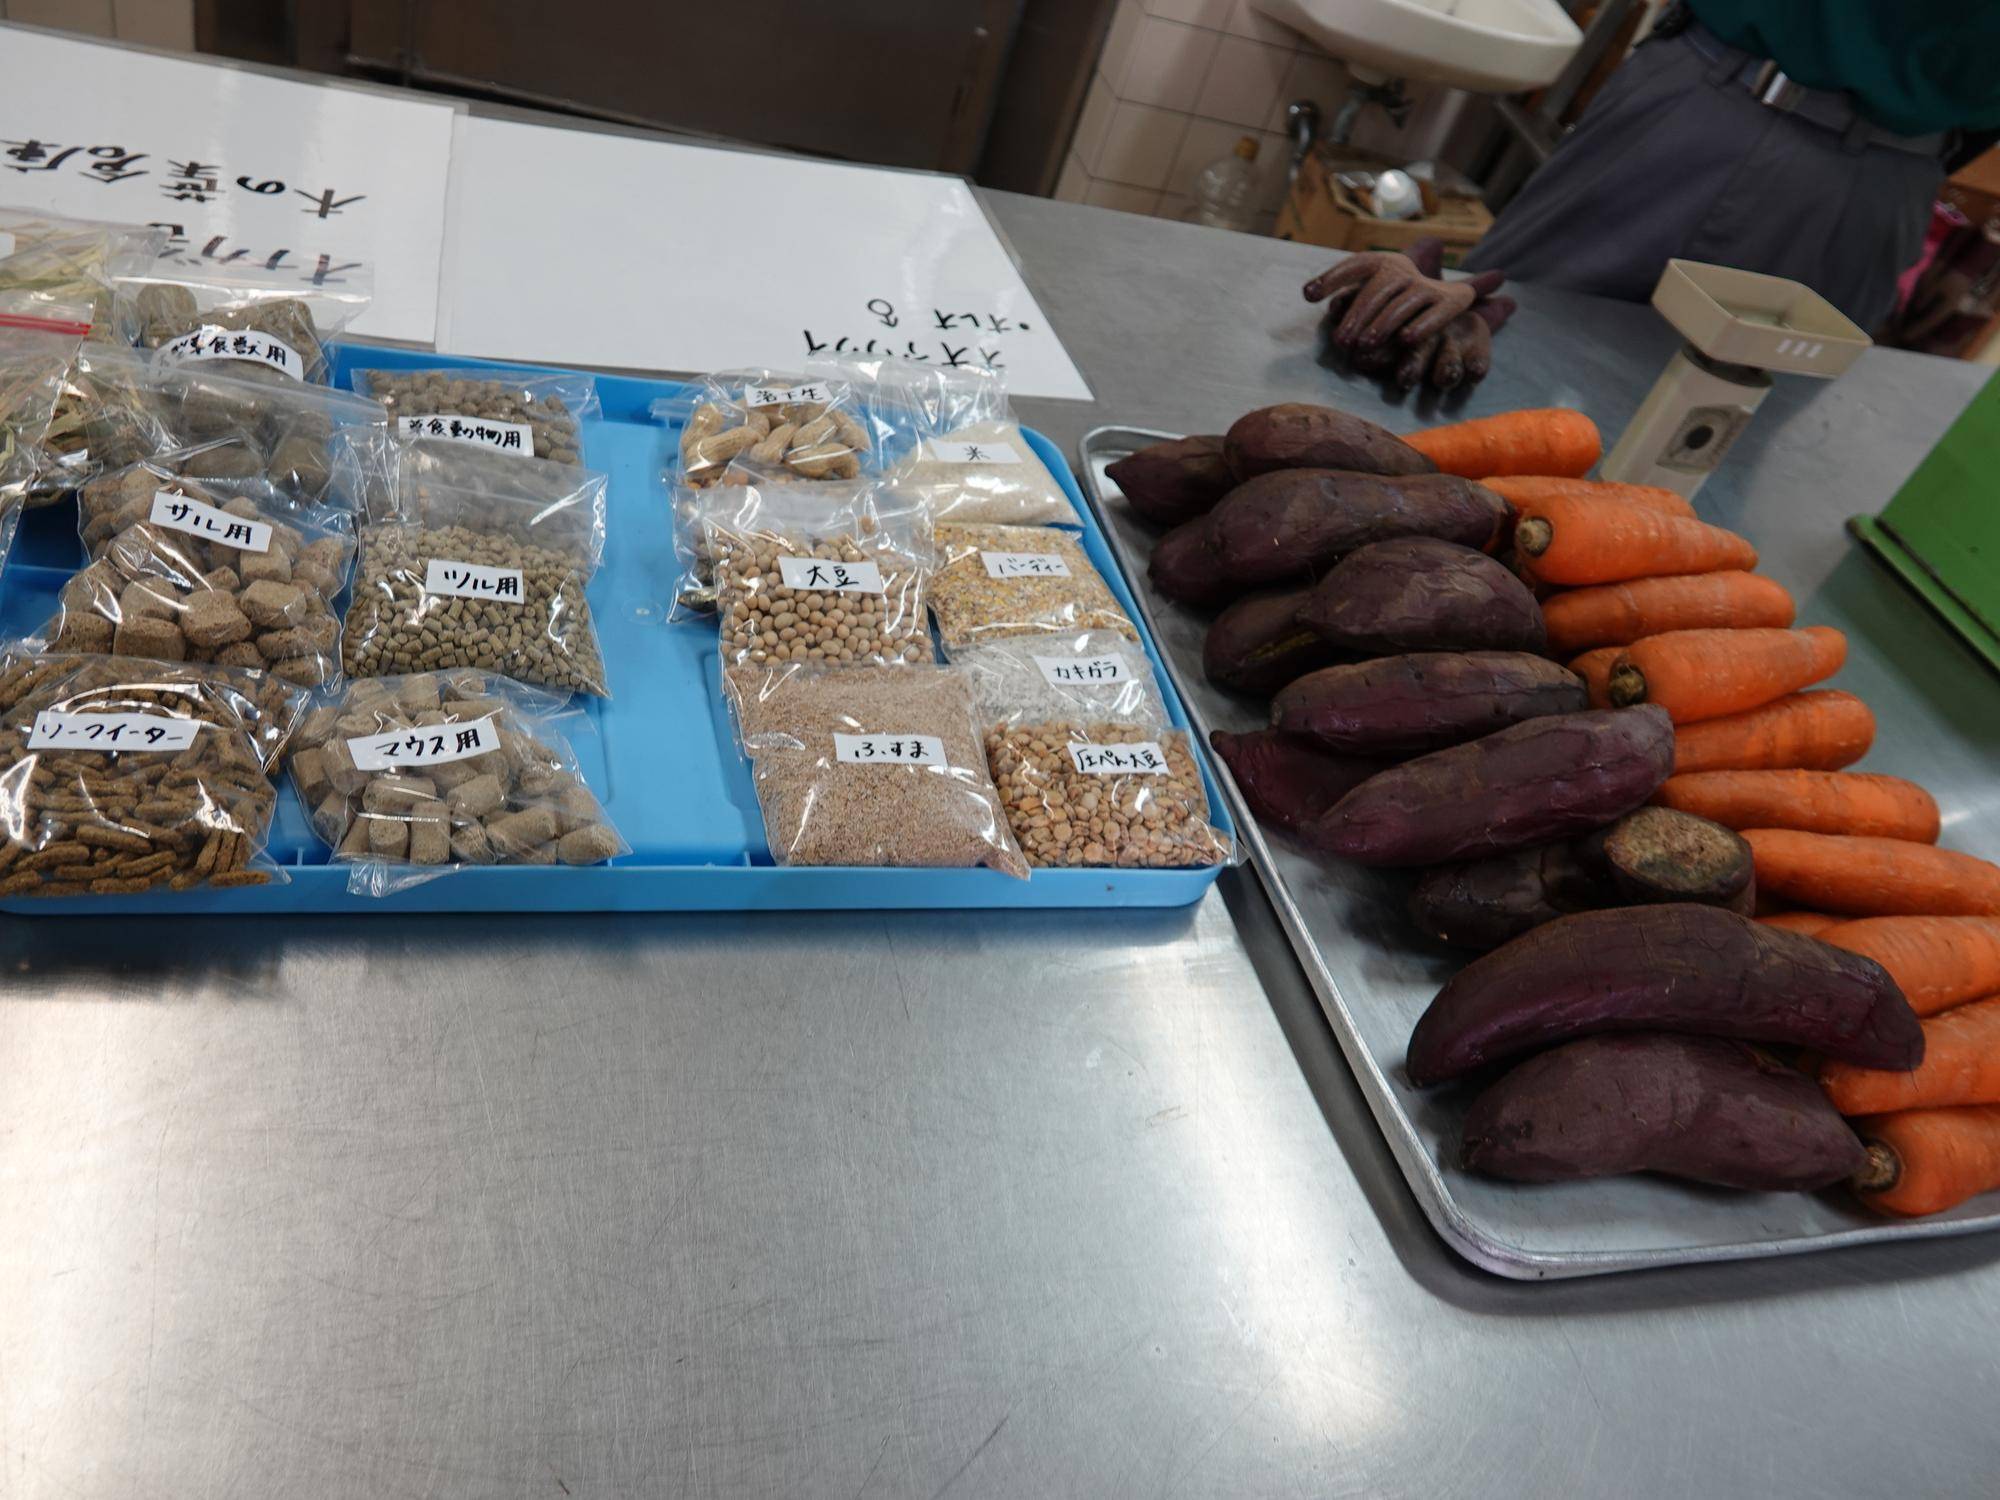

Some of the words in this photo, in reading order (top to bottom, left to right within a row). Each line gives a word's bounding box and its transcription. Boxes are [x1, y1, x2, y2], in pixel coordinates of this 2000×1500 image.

[963, 445, 991, 461] 米
[165, 504, 252, 545] サル用
[444, 570, 518, 597] ツル用
[806, 565, 860, 587] 大豆
[1053, 661, 1117, 679] カキガラ
[375, 728, 481, 757] マウス用
[854, 740, 929, 758] ふすま
